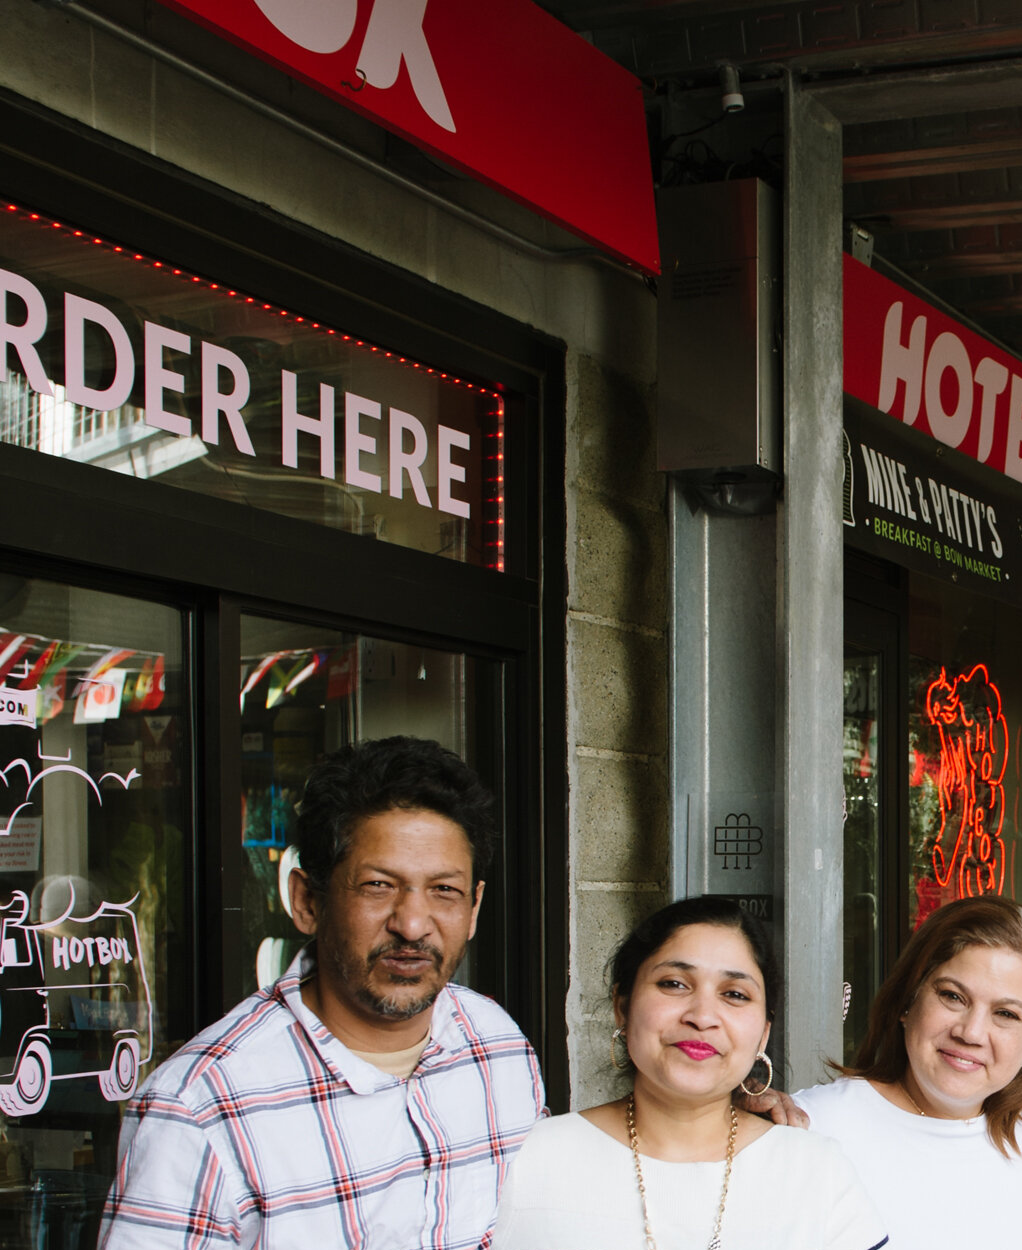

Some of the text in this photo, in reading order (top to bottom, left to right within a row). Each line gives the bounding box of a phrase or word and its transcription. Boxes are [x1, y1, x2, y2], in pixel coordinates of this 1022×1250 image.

[281, 369, 470, 519] HERE
[860, 443, 1003, 558] MIKE & PATTY'S
[874, 517, 1001, 582] BREAKFAST @ BOW MARKET
[53, 936, 133, 971] HOTBOX
